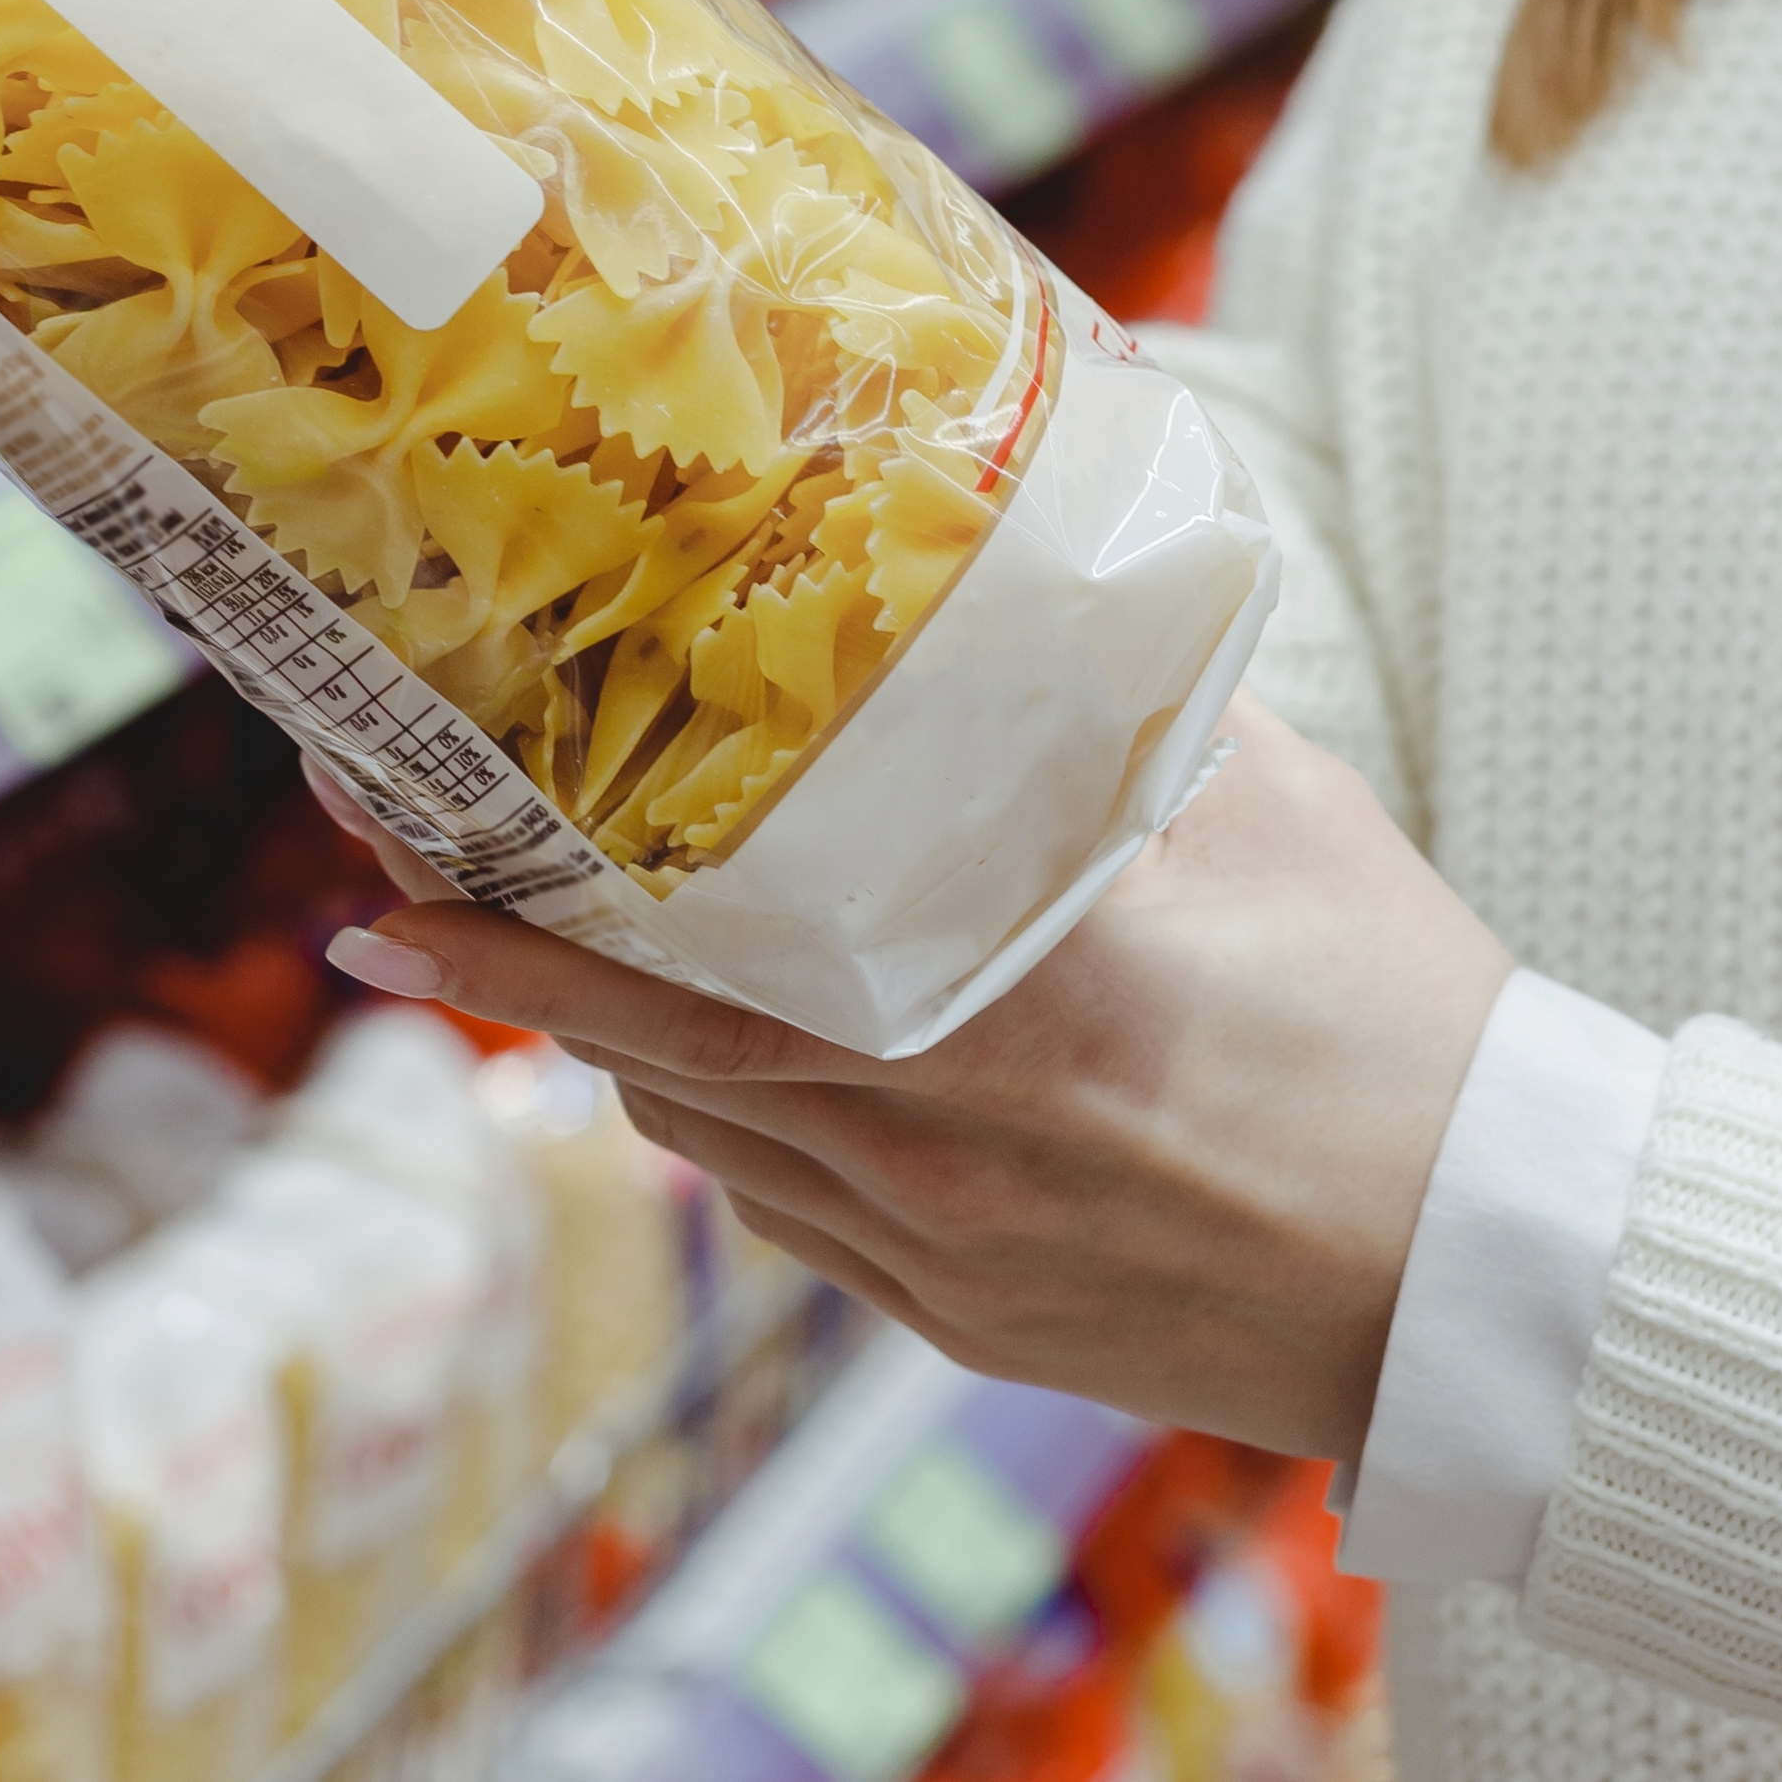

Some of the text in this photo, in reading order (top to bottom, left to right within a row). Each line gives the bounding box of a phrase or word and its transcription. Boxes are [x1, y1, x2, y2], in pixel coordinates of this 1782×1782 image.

[221, 538, 247, 560] 14%
[254, 568, 281, 590] 20%
[273, 584, 300, 605] 15%
[258, 627, 281, 645] 0,8
[293, 601, 315, 619] 1%
[324, 627, 348, 644] 0%
[437, 729, 460, 750] 0%
[453, 746, 481, 771] 10%
[473, 765, 496, 786] 0%
